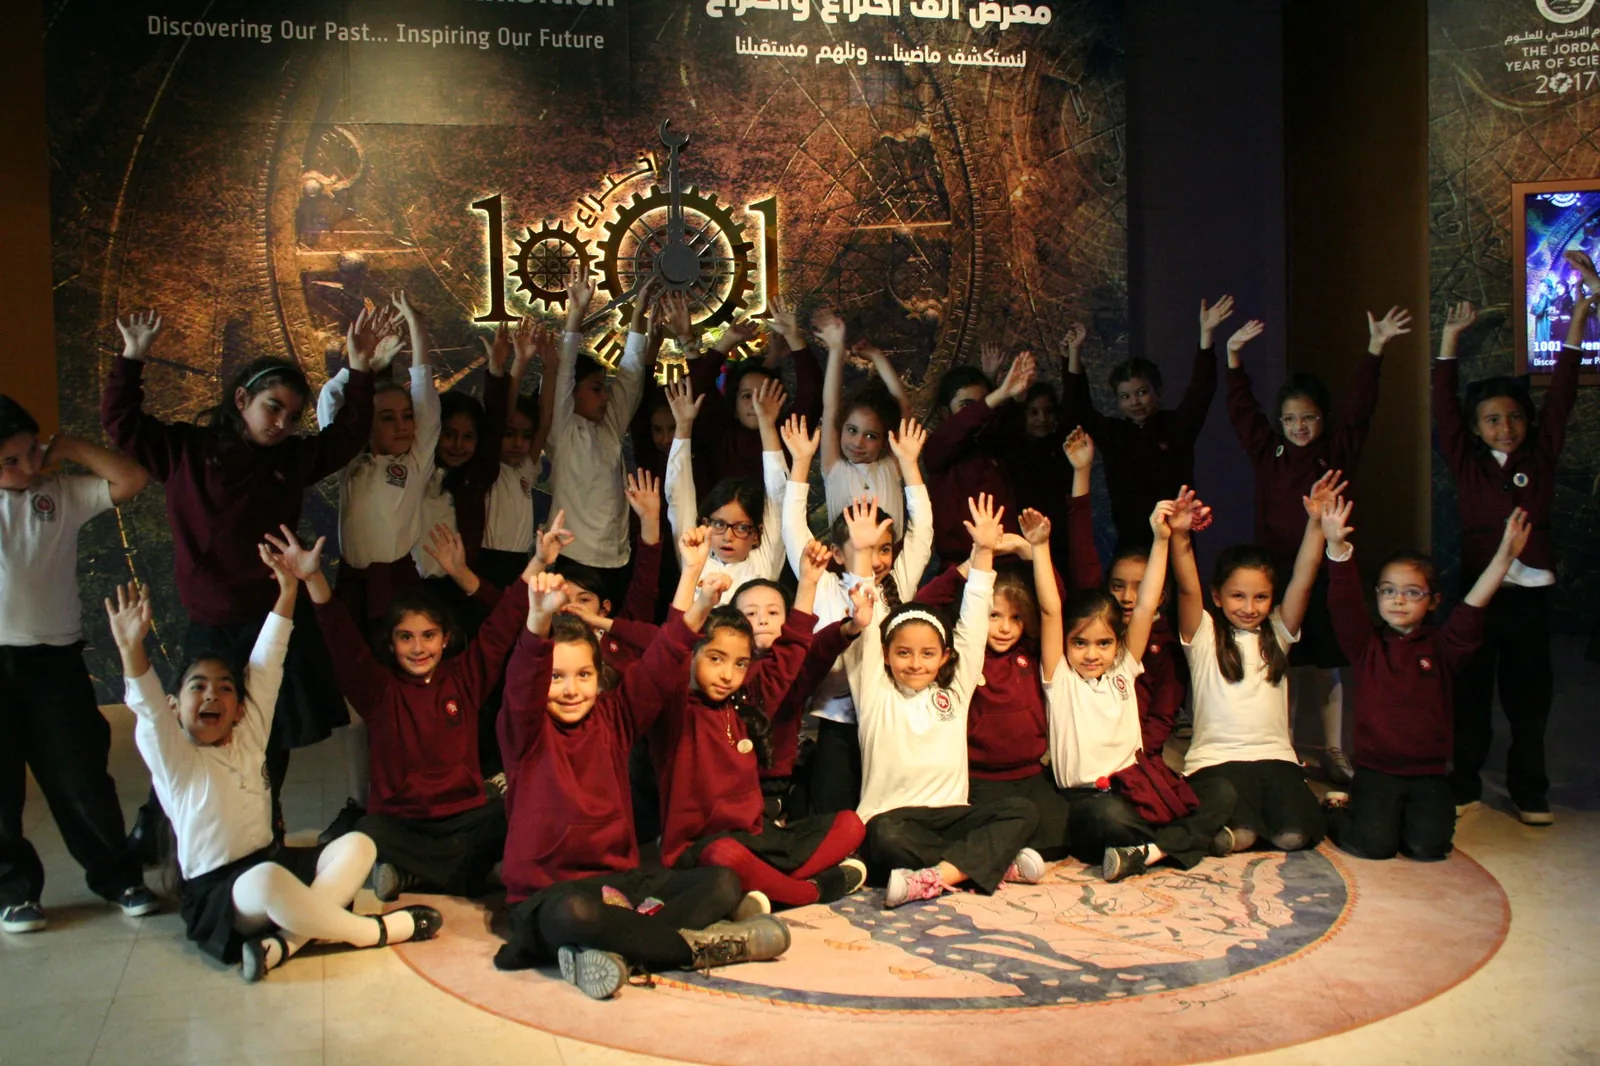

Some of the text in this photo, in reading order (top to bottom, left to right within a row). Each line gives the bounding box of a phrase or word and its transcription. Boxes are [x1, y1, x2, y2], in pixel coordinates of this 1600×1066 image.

[148, 15, 605, 50] Discovering Our Past... Inspiring Our Future
[735, 36, 808, 60] مستقبلنا
[815, 41, 868, 65] ونلهم
[947, 45, 1027, 68] لنستكشف
[1522, 41, 1600, 57] THE JORDA
[1505, 54, 1600, 72] YEAR OF SCIE
[1535, 71, 1597, 94] 2017
[1533, 340, 1562, 352] 1001
